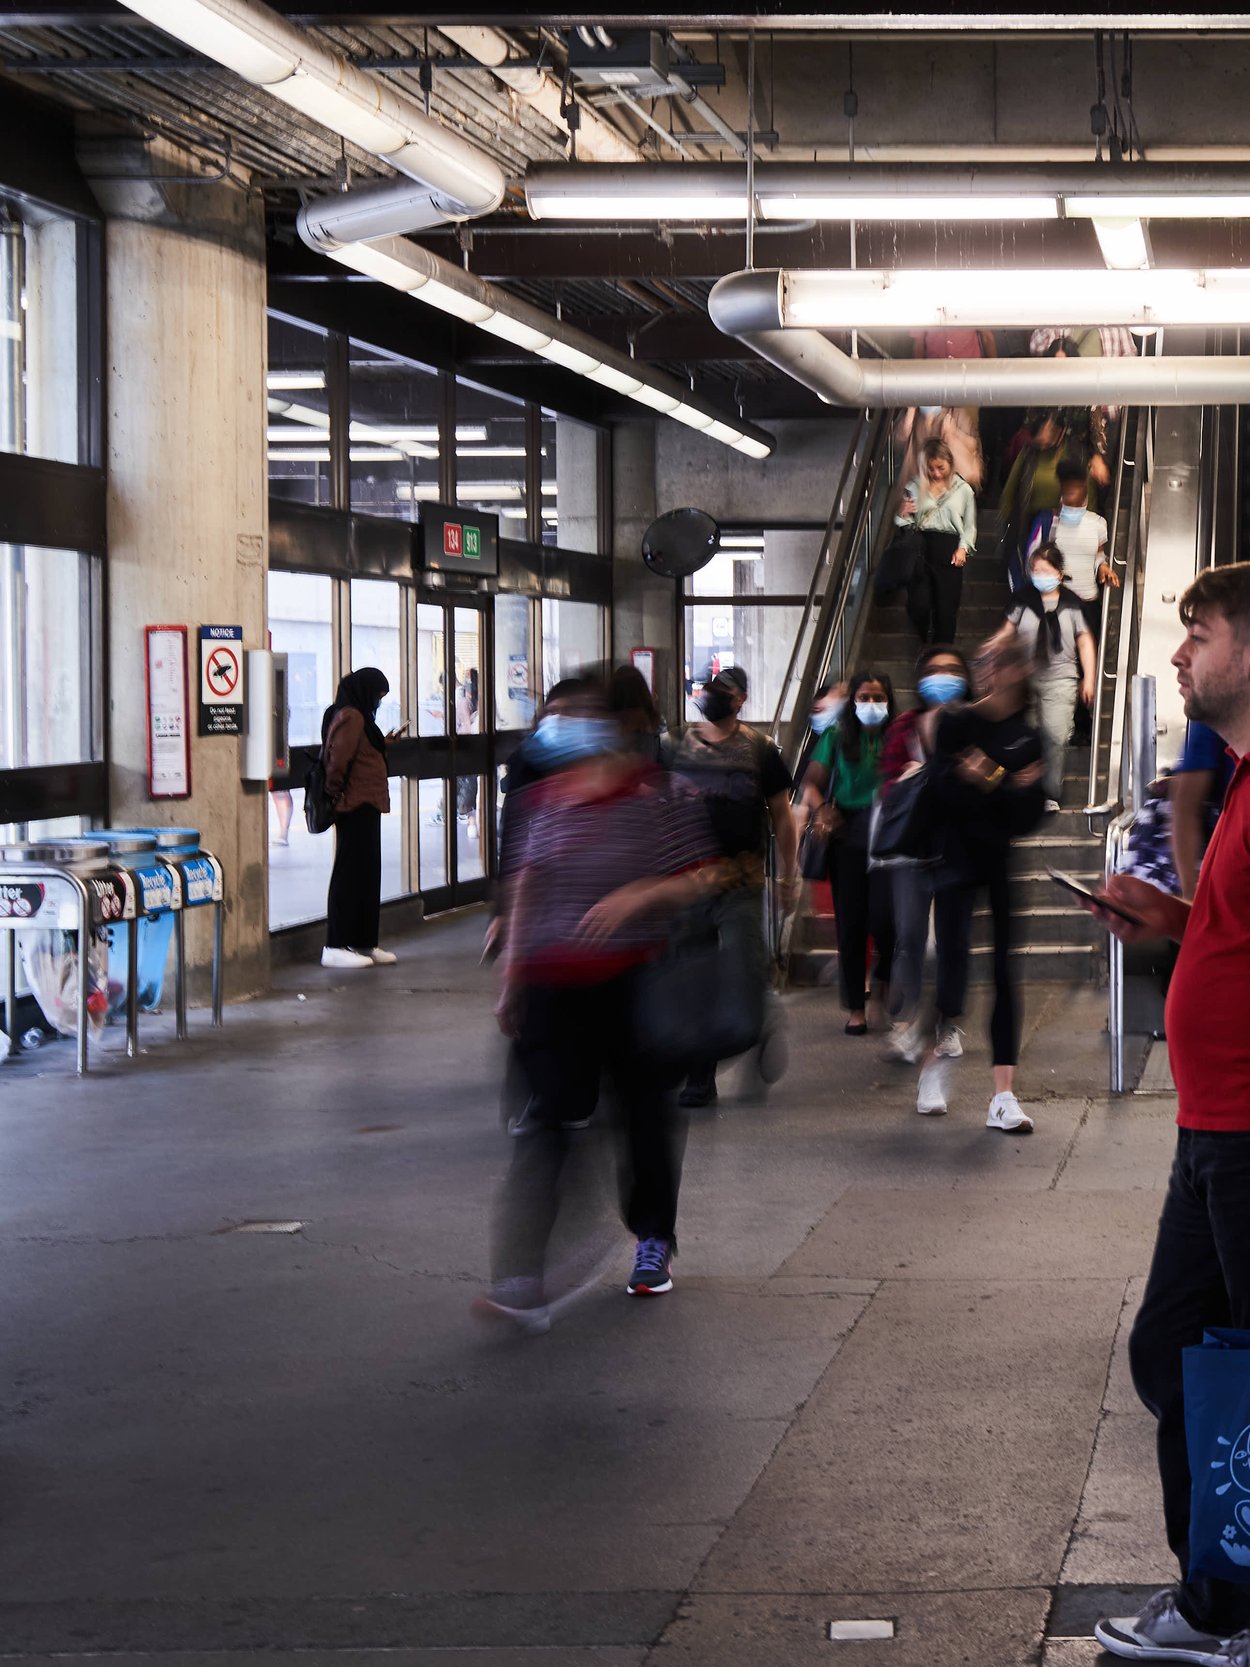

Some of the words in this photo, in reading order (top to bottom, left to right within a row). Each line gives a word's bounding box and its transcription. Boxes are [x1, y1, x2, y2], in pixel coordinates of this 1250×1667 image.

[448, 529, 459, 550] 134
[210, 628, 234, 638] NOTICE
[139, 869, 166, 889] Recycle
[184, 862, 208, 881] Recycle
